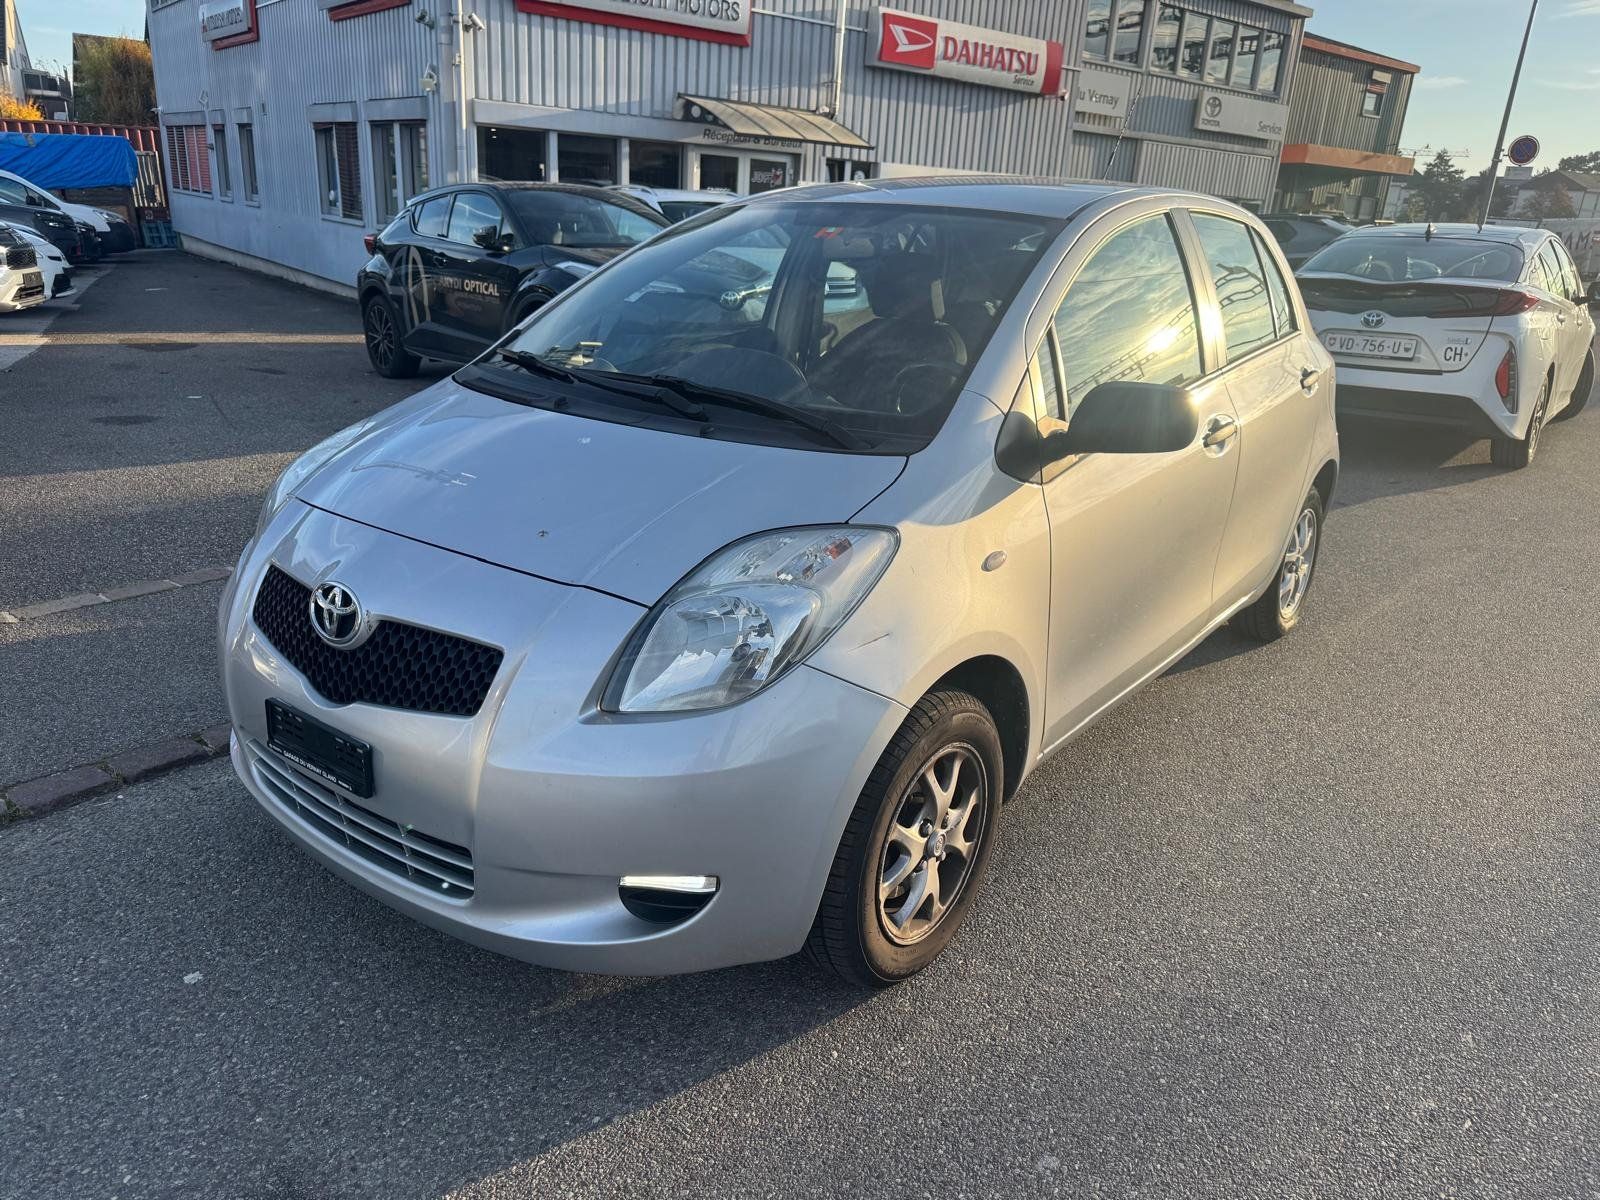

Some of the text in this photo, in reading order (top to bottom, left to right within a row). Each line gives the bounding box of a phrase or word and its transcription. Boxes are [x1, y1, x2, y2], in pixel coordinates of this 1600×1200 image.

[674, 0, 740, 21] MOTORS
[942, 36, 1040, 76] DAIHATSU
[1012, 73, 1035, 87] Service
[1257, 120, 1282, 135] Service
[463, 279, 499, 296] OPTICAL
[1444, 346, 1463, 362] CH
[283, 750, 299, 763] GARAGE
